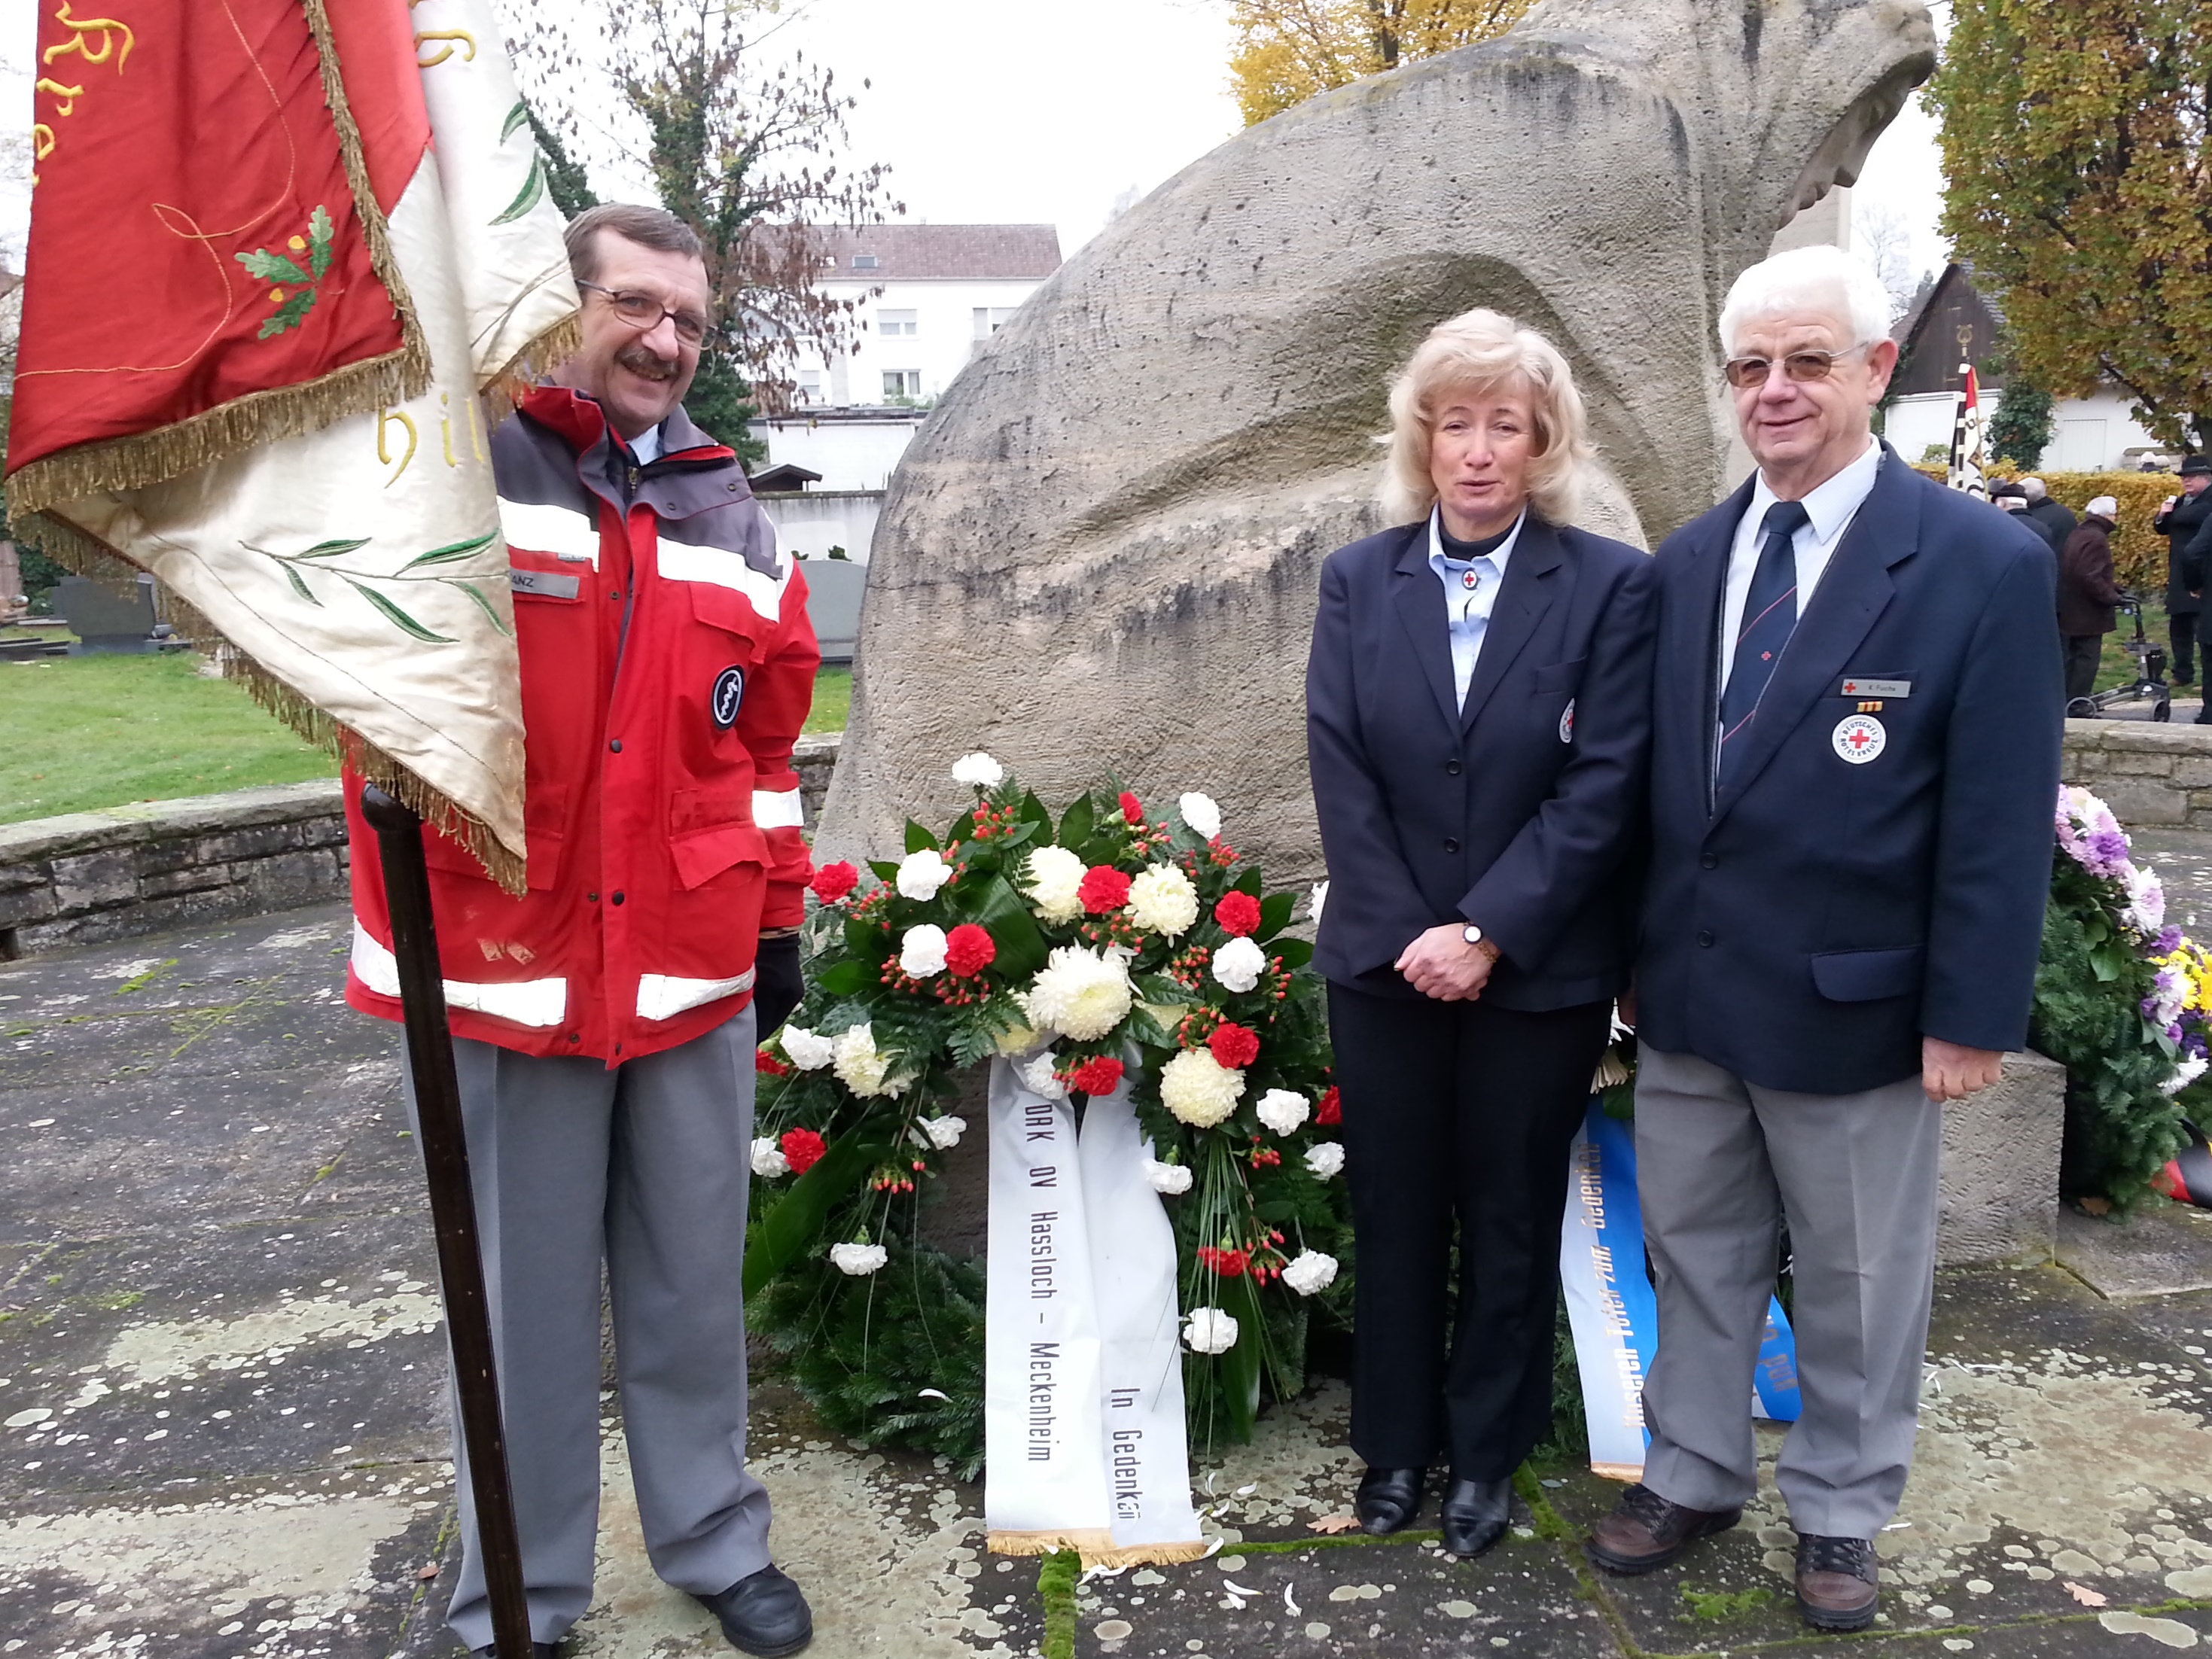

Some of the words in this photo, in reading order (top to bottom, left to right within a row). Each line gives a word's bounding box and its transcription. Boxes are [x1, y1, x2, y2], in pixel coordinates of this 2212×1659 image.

[510, 574, 535, 588] ANZ
[1839, 738, 1856, 756] ROTES
[1857, 738, 1878, 757] KREUZ
[1842, 720, 1878, 735] DEUTSCHES
[1024, 1103, 1056, 1143] DRK
[1028, 1165, 1058, 1189] OV
[1574, 1143, 1607, 1230] Gedenken
[1030, 1210, 1059, 1300] Hassloch
[1590, 1243, 1616, 1283] zum
[1599, 1288, 1635, 1338] Toten
[1028, 1342, 1061, 1462] Meckenheim
[1110, 1387, 1141, 1409] In
[1614, 1348, 1647, 1428] Unseren
[1112, 1429, 1144, 1520] Gedenken
